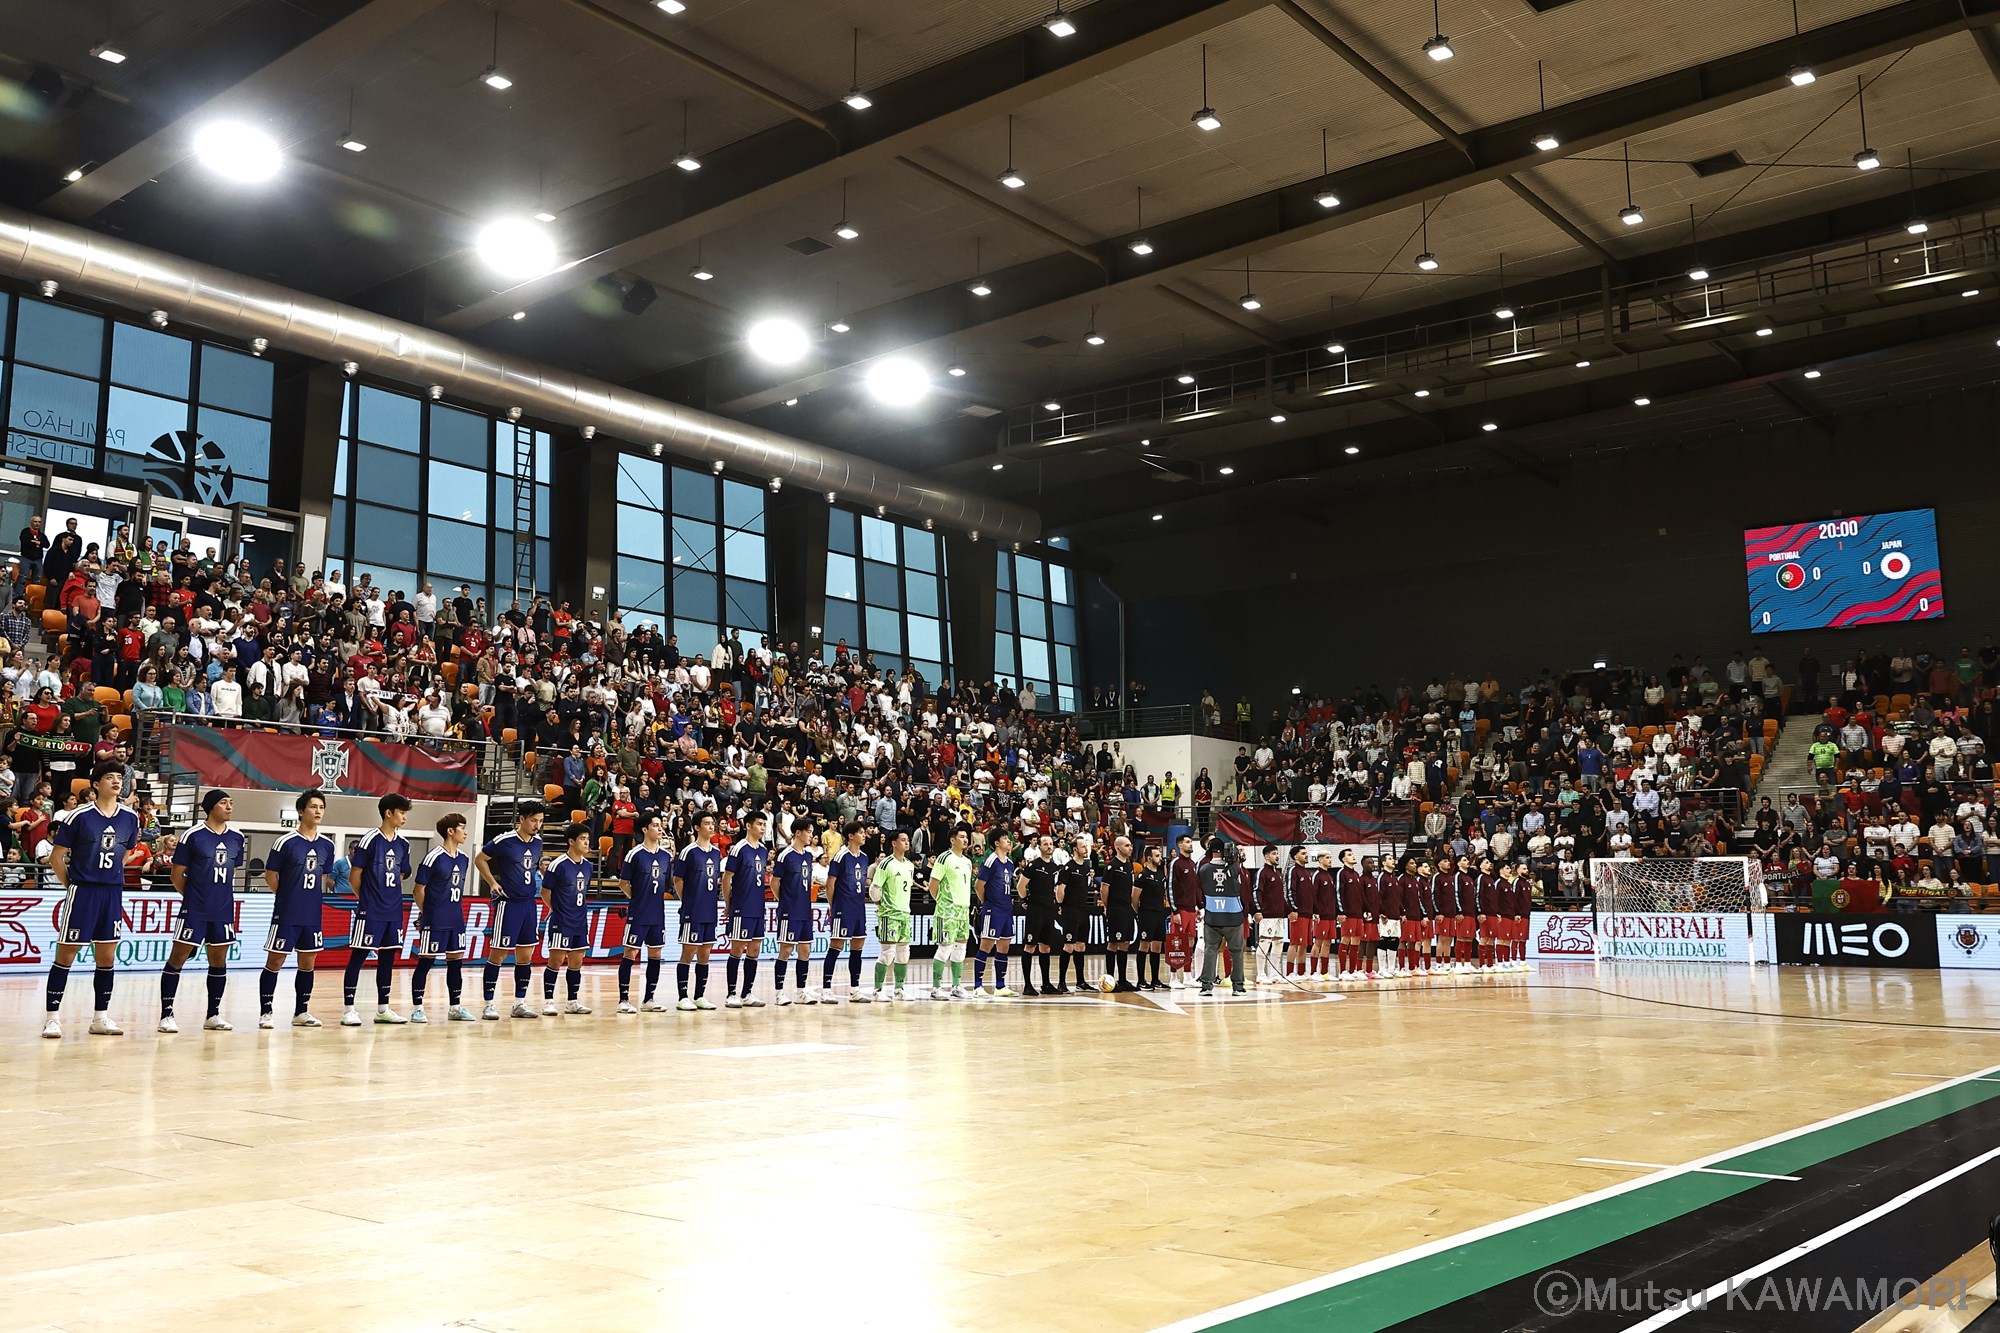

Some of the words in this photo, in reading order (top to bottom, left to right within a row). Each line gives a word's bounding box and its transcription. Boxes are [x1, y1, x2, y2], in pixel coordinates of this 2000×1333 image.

[1819, 520, 1858, 540] 20:00
[1881, 540, 1903, 550] JAPAN
[1769, 551, 1800, 562] PORTUGAL
[1813, 567, 1821, 581] 0
[1863, 562, 1871, 575] 0
[1920, 598, 1928, 612] 0
[1763, 612, 1770, 625] 0
[98, 852, 114, 869] 15
[213, 867, 227, 884] 14
[303, 873, 316, 890] 13
[385, 872, 396, 888] 12
[524, 870, 532, 885] 9
[756, 874, 761, 887] 5
[963, 874, 967, 884] 1
[1763, 870, 1802, 881] PORTUGAL
[652, 881, 659, 894] 7
[707, 878, 713, 891] 6
[802, 878, 808, 892] 4
[856, 881, 862, 894] 3
[903, 881, 908, 892] 2
[1004, 885, 1010, 895] 11
[450, 887, 461, 902] 10
[576, 893, 583, 907] 8
[1214, 899, 1226, 910] TV
[1603, 916, 1726, 940] GENERALI
[313, 931, 323, 947] 13
[1803, 922, 1910, 958] MEO
[1604, 941, 1727, 958] TRANQUILIDADE
